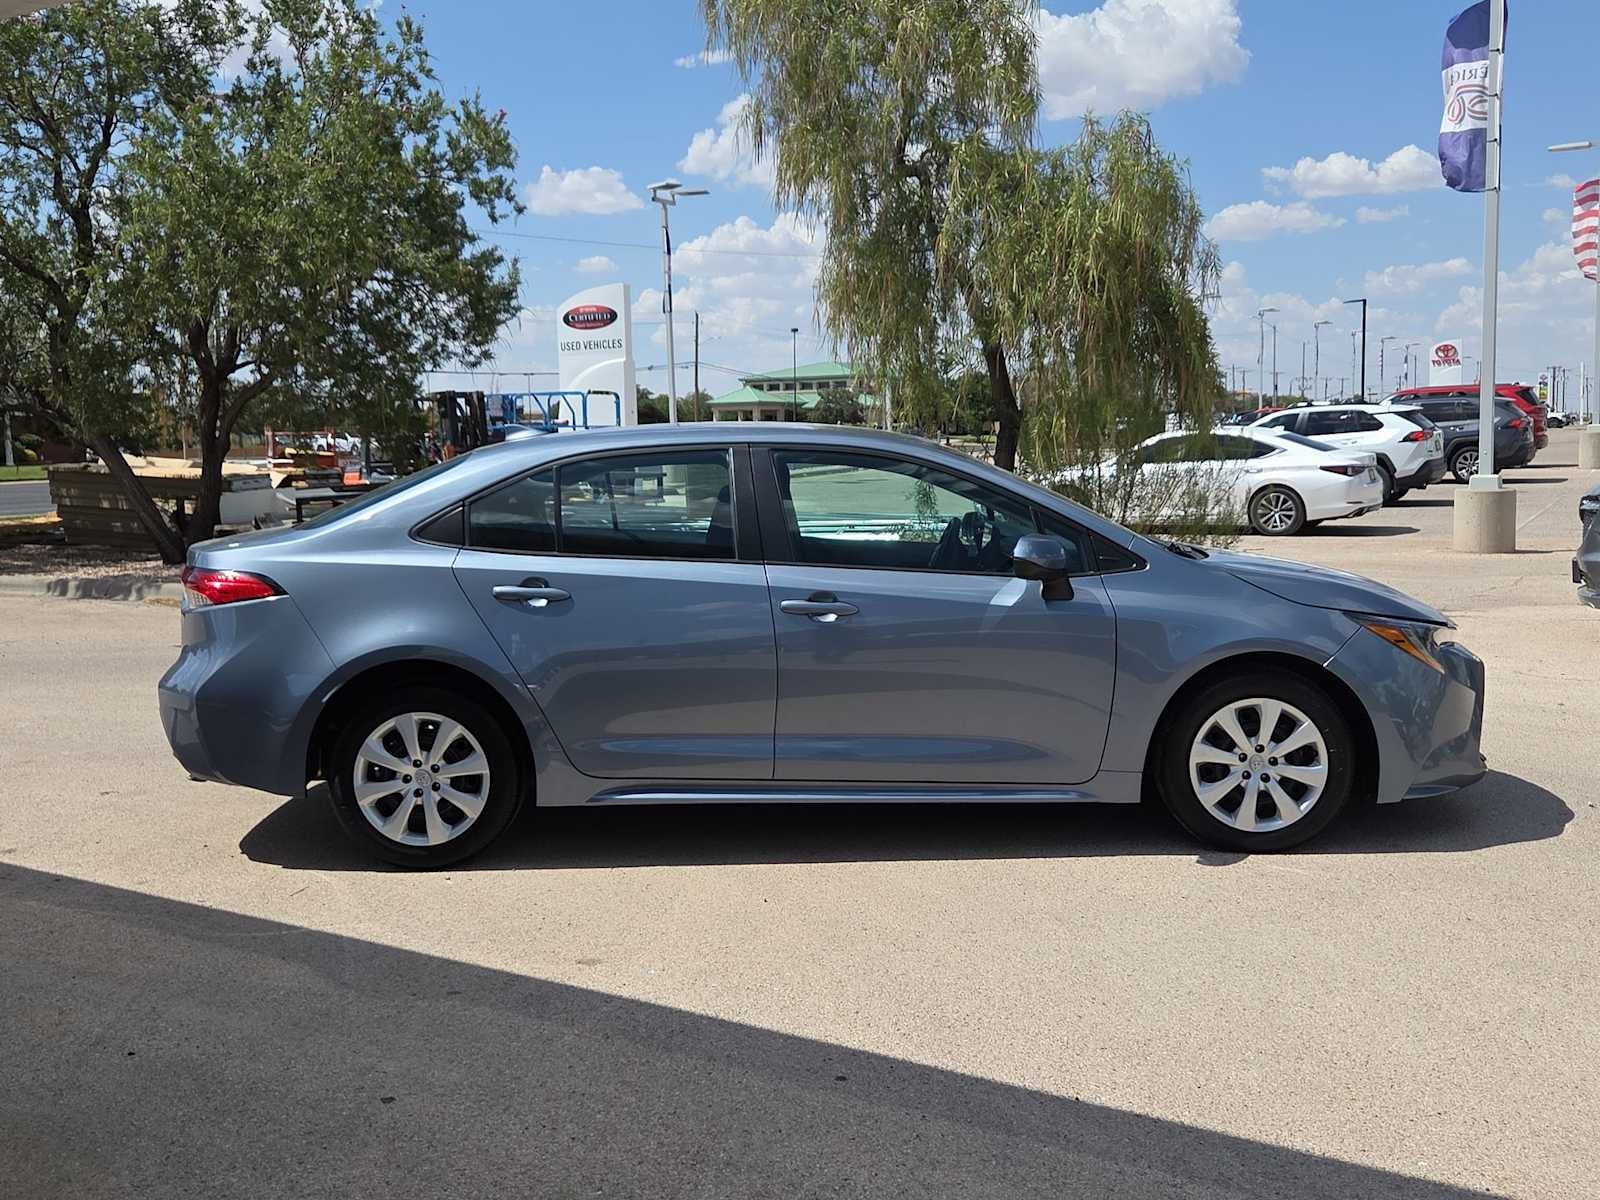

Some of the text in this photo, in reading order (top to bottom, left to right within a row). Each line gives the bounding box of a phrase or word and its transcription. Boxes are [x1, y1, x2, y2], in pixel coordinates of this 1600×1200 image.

[560, 338, 623, 352] USED VEHICLES
[1431, 358, 1461, 367] TOYOTA
